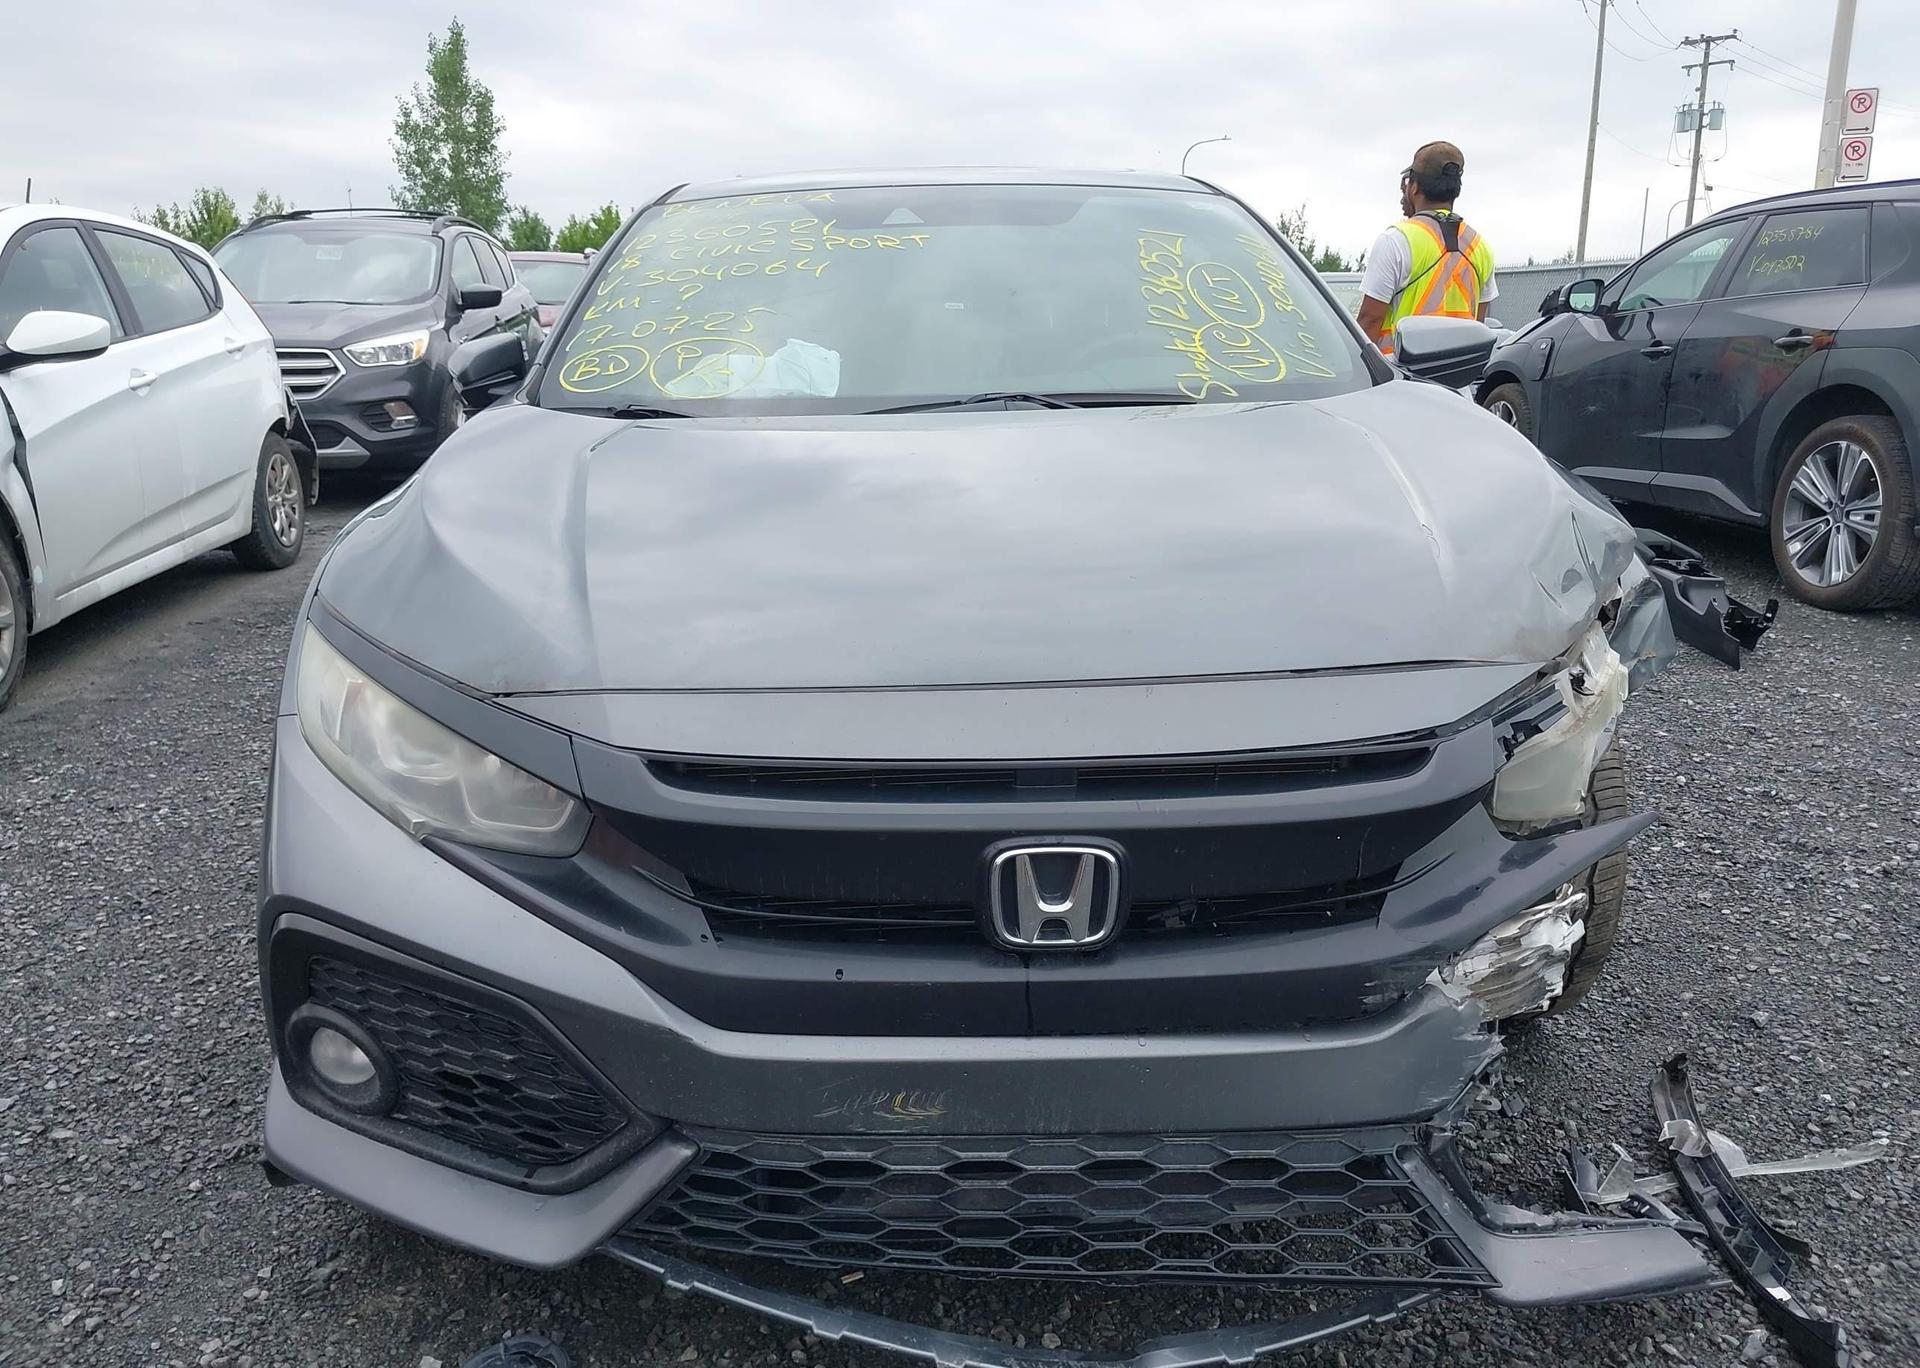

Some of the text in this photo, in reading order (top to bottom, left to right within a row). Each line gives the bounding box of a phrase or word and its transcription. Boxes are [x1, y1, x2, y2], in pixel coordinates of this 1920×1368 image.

[608, 233, 931, 274] 18 CIVIC SPORT
